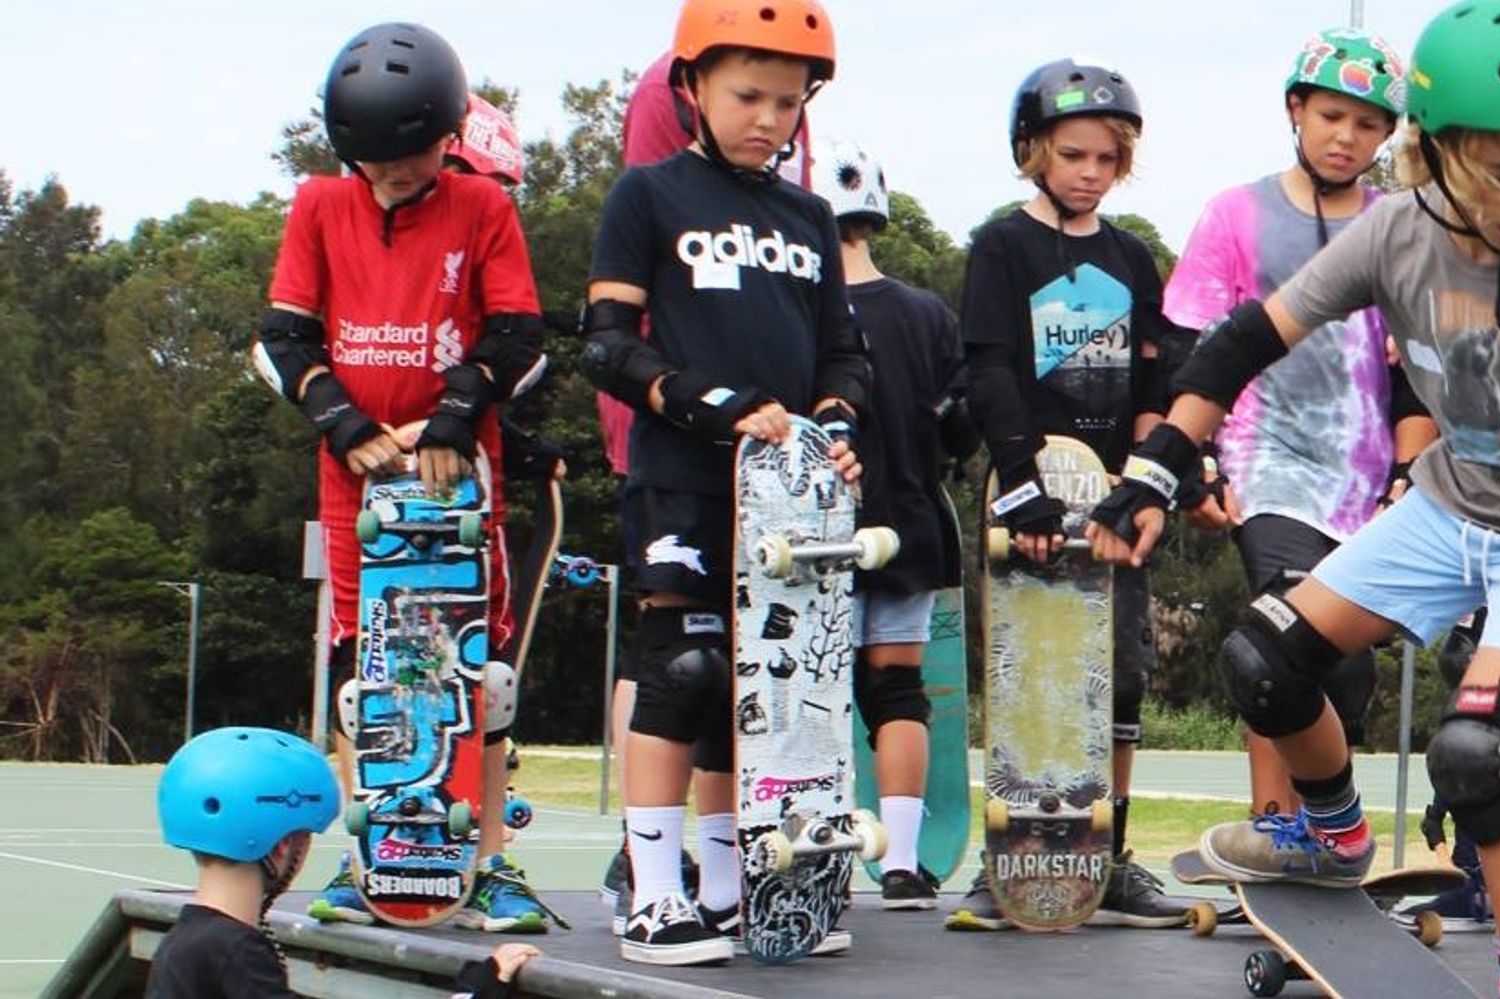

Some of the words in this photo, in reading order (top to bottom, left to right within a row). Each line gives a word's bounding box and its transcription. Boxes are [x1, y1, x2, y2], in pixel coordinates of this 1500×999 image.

[677, 224, 822, 284] adidas
[339, 318, 428, 344] Standard
[1046, 325, 1116, 348] Hurley
[332, 340, 427, 367] Chartered
[1044, 471, 1101, 503] ENZO
[997, 853, 1103, 881] DARKSTAR
[368, 874, 460, 898] BOARDERS
